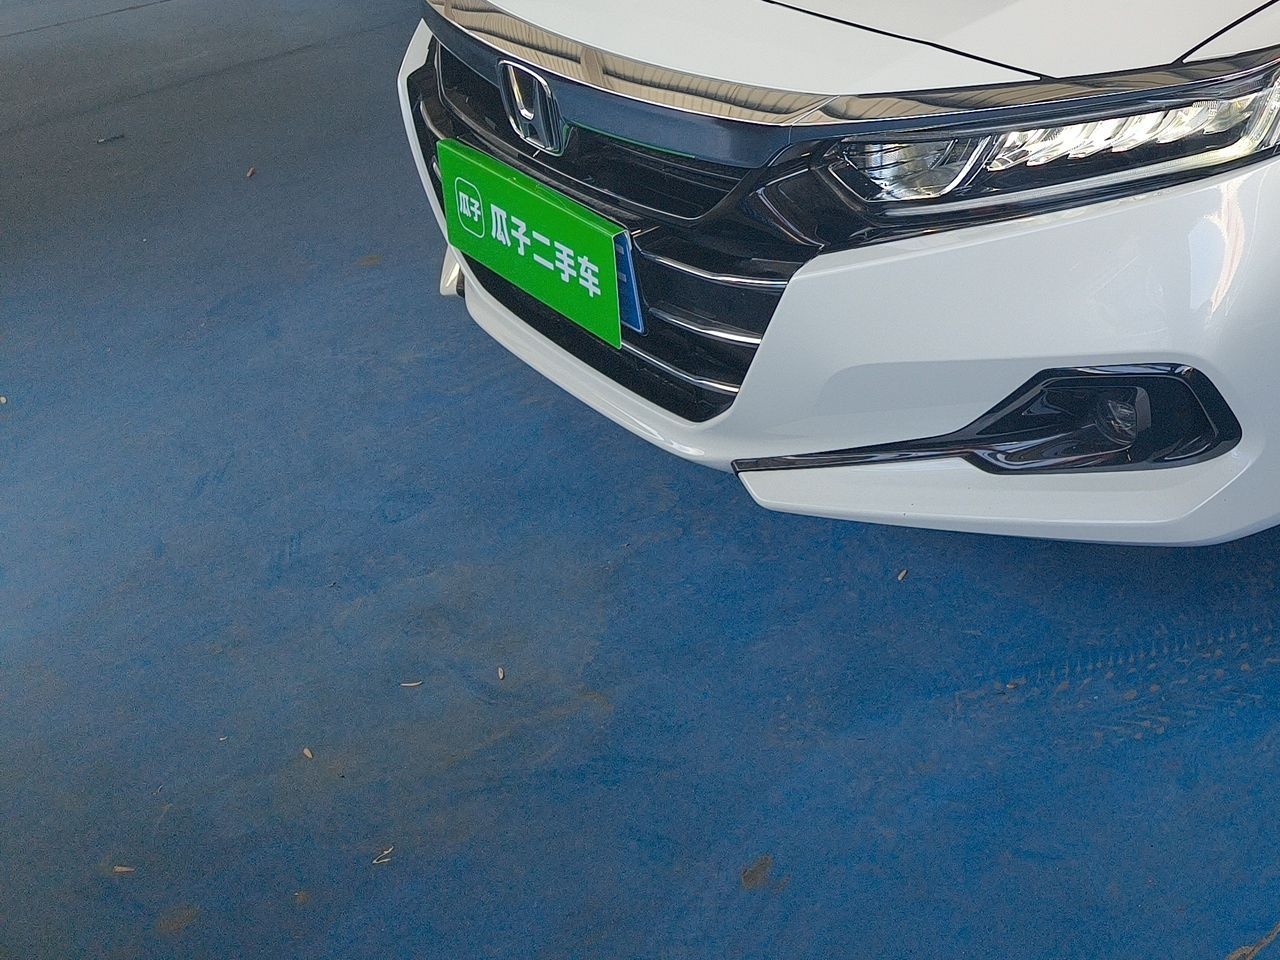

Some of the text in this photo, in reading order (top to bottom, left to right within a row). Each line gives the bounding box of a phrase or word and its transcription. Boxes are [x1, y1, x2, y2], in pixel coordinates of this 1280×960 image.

[458, 191, 482, 222] 瓜子
[490, 203, 602, 298] 瓜子二手车
